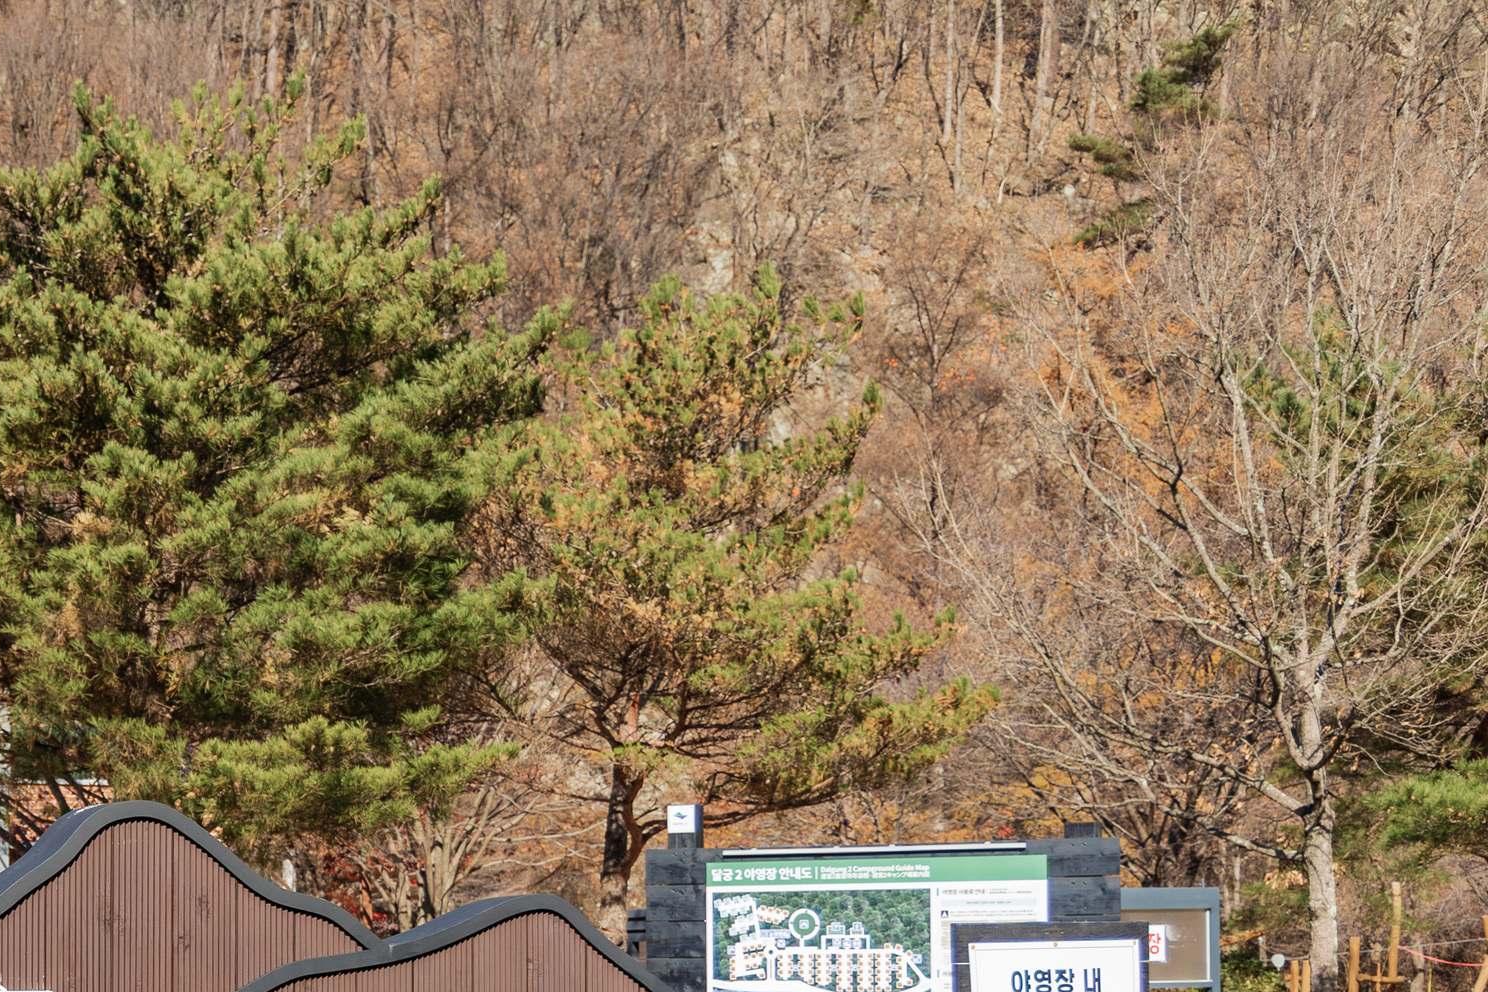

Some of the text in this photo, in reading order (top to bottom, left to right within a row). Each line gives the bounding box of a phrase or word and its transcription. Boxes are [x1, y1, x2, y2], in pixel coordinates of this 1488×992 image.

[711, 868, 733, 882] 달궁
[734, 869, 743, 881] 2
[744, 867, 777, 881] 야영장
[778, 866, 812, 880] 안내도
[852, 865, 895, 873] Campground
[915, 864, 930, 872] Map
[1084, 968, 1101, 992] 내
